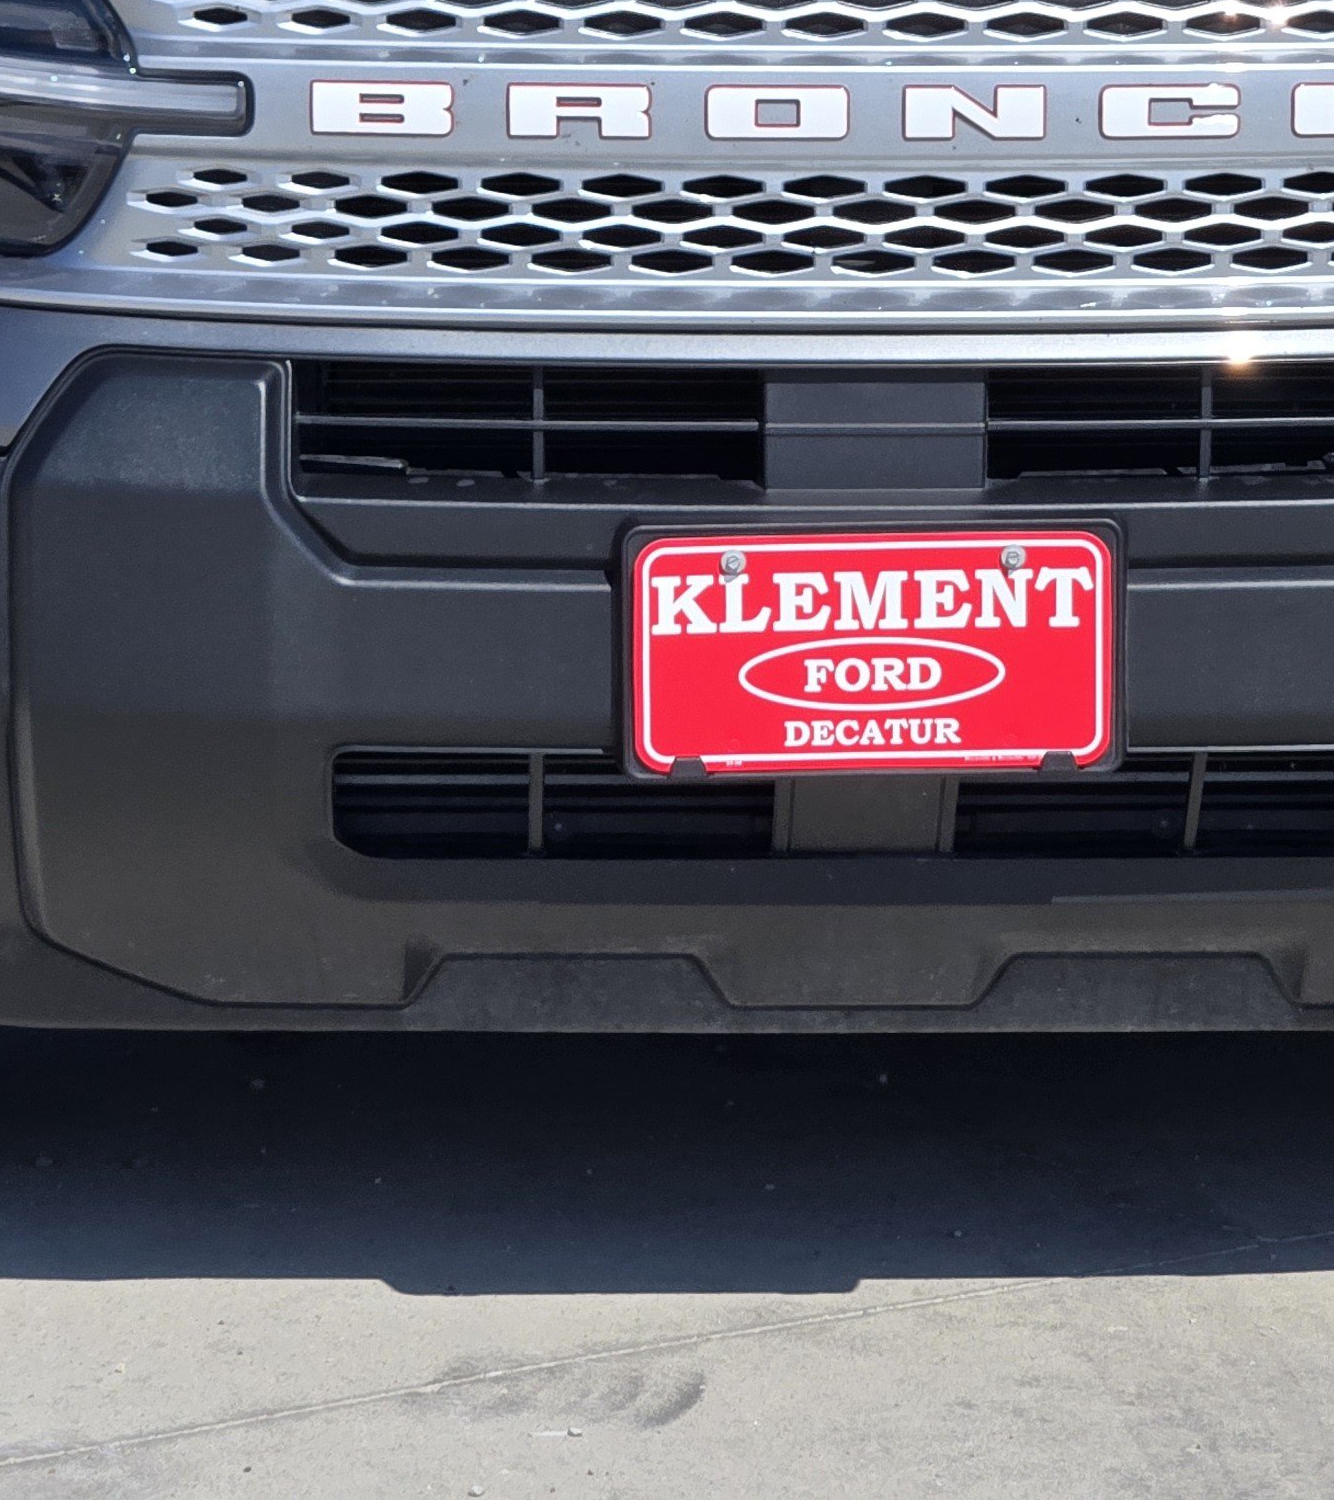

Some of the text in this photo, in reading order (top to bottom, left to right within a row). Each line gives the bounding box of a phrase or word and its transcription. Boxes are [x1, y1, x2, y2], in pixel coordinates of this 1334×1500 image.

[651, 566, 1094, 635] KLEMENT
[804, 657, 942, 693] FORD
[784, 717, 962, 747] DECATUR
